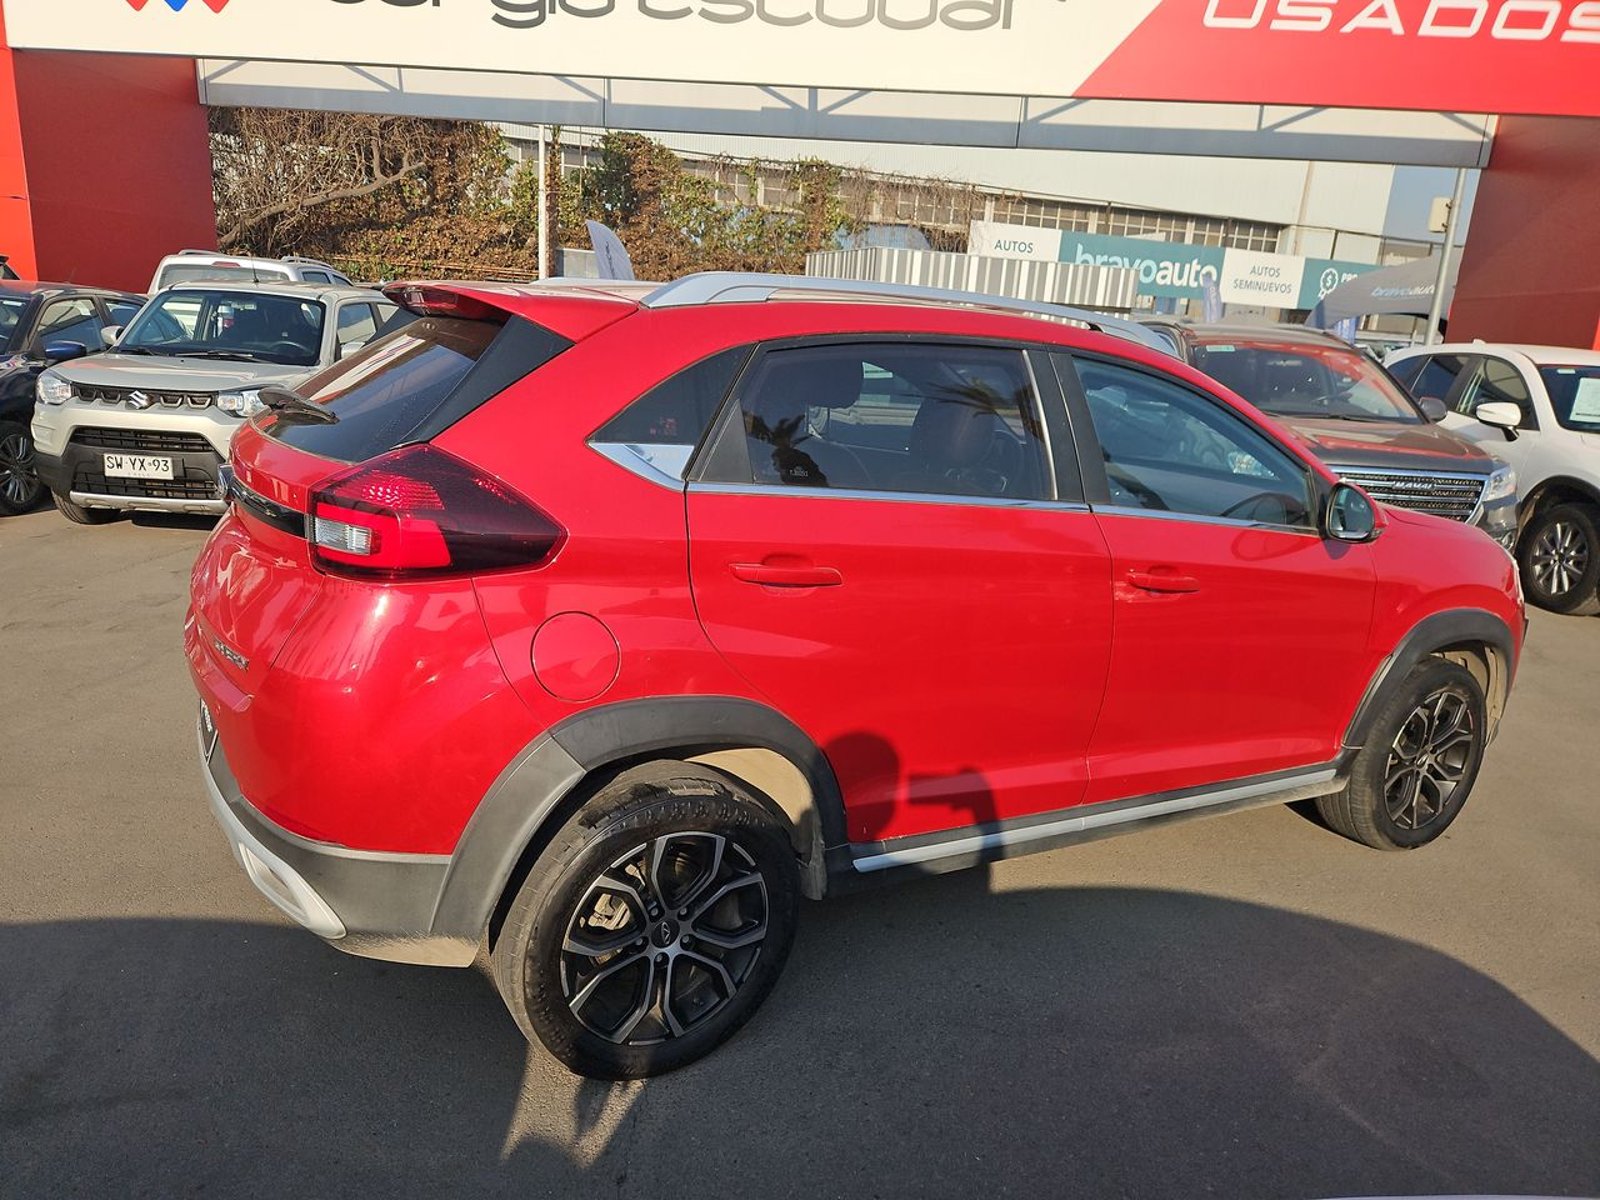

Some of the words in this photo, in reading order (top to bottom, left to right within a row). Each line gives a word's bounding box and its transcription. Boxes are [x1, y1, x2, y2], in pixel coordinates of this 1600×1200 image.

[1202, 0, 1600, 43] USADOS
[994, 239, 1034, 254] AUTOS
[1250, 265, 1281, 278] AUTOS
[1233, 278, 1292, 294] SEMINUEVOS
